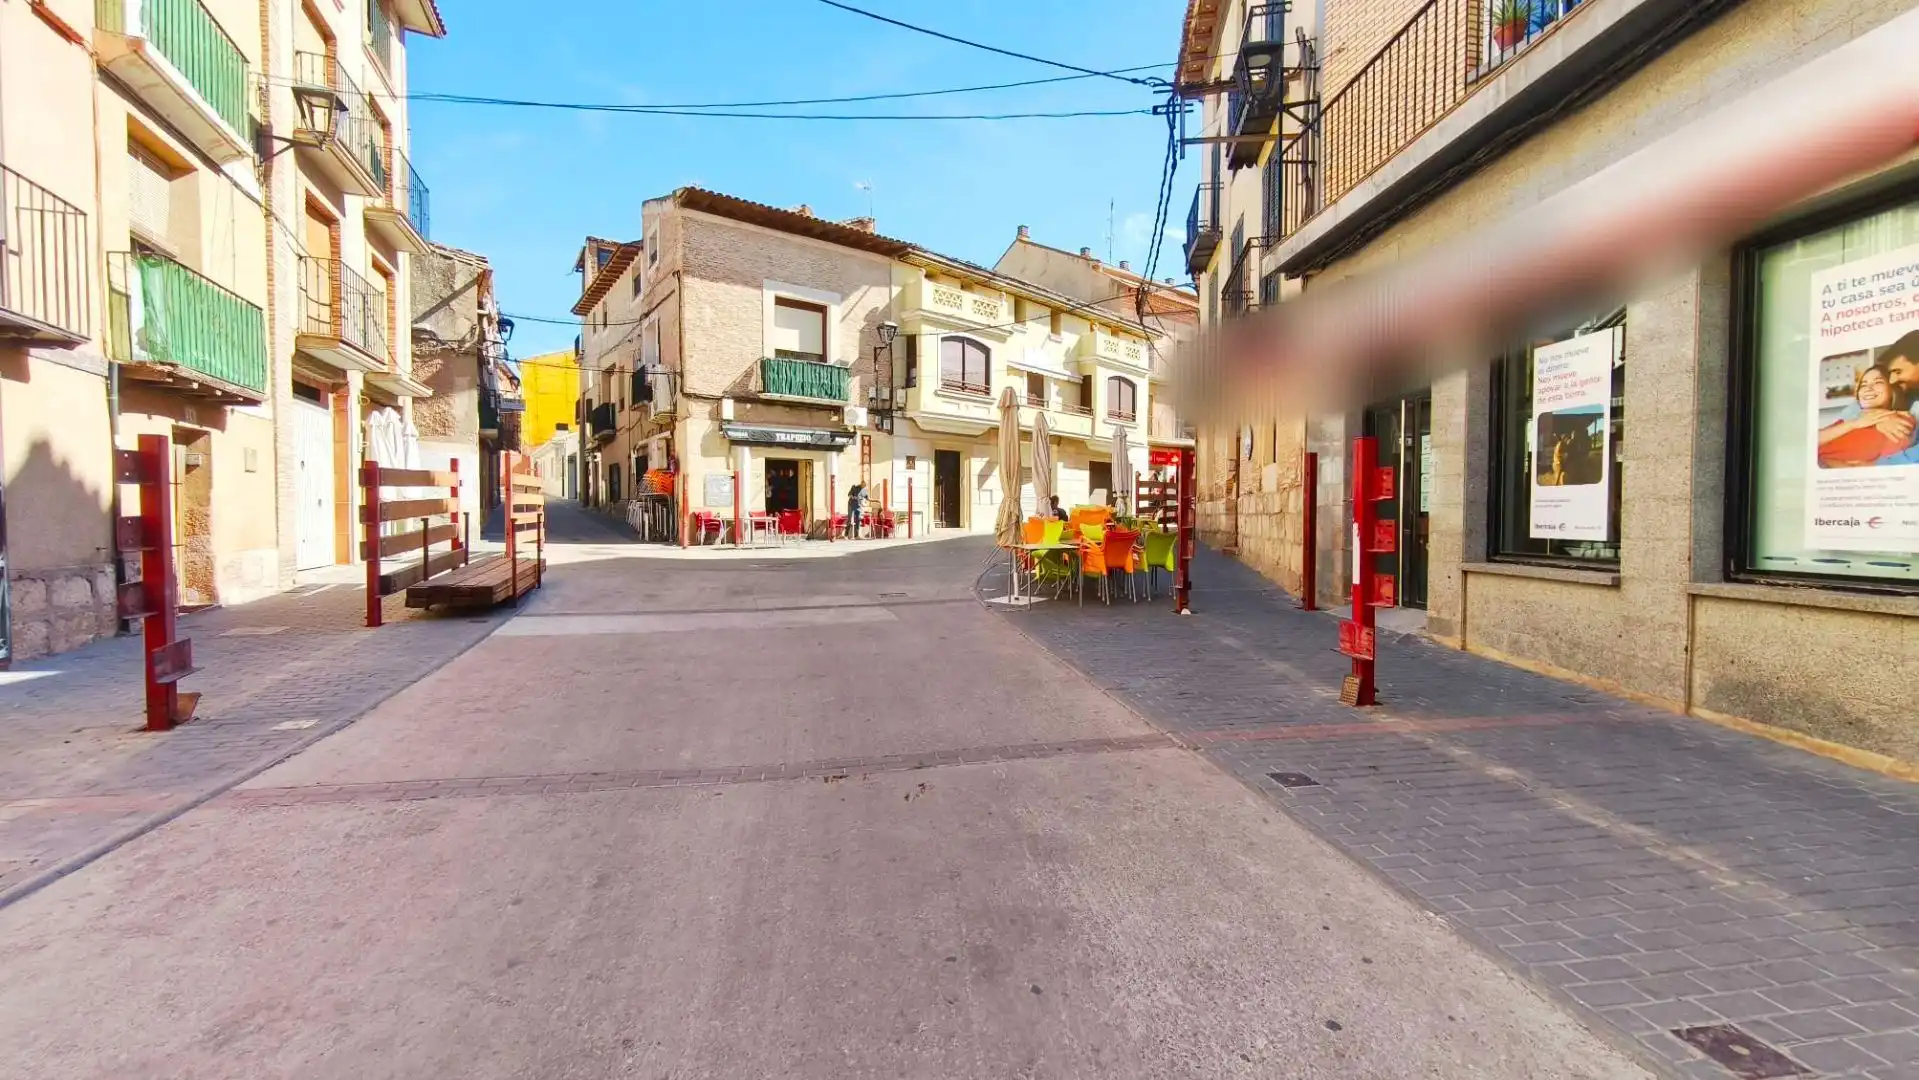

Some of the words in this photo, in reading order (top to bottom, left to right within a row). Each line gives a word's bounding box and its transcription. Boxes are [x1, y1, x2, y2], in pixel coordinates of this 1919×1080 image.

[1822, 284, 1832, 295] A
[1837, 278, 1846, 291] ti
[1852, 275, 1866, 288] te
[1822, 298, 1836, 309] tu
[1840, 290, 1874, 304] casa
[1879, 282, 1906, 296] sea
[1822, 312, 1832, 323] A
[1836, 298, 1906, 320] nosotros,
[1821, 317, 1884, 337] hipoteca
[1814, 516, 1860, 528] Ibercaja
